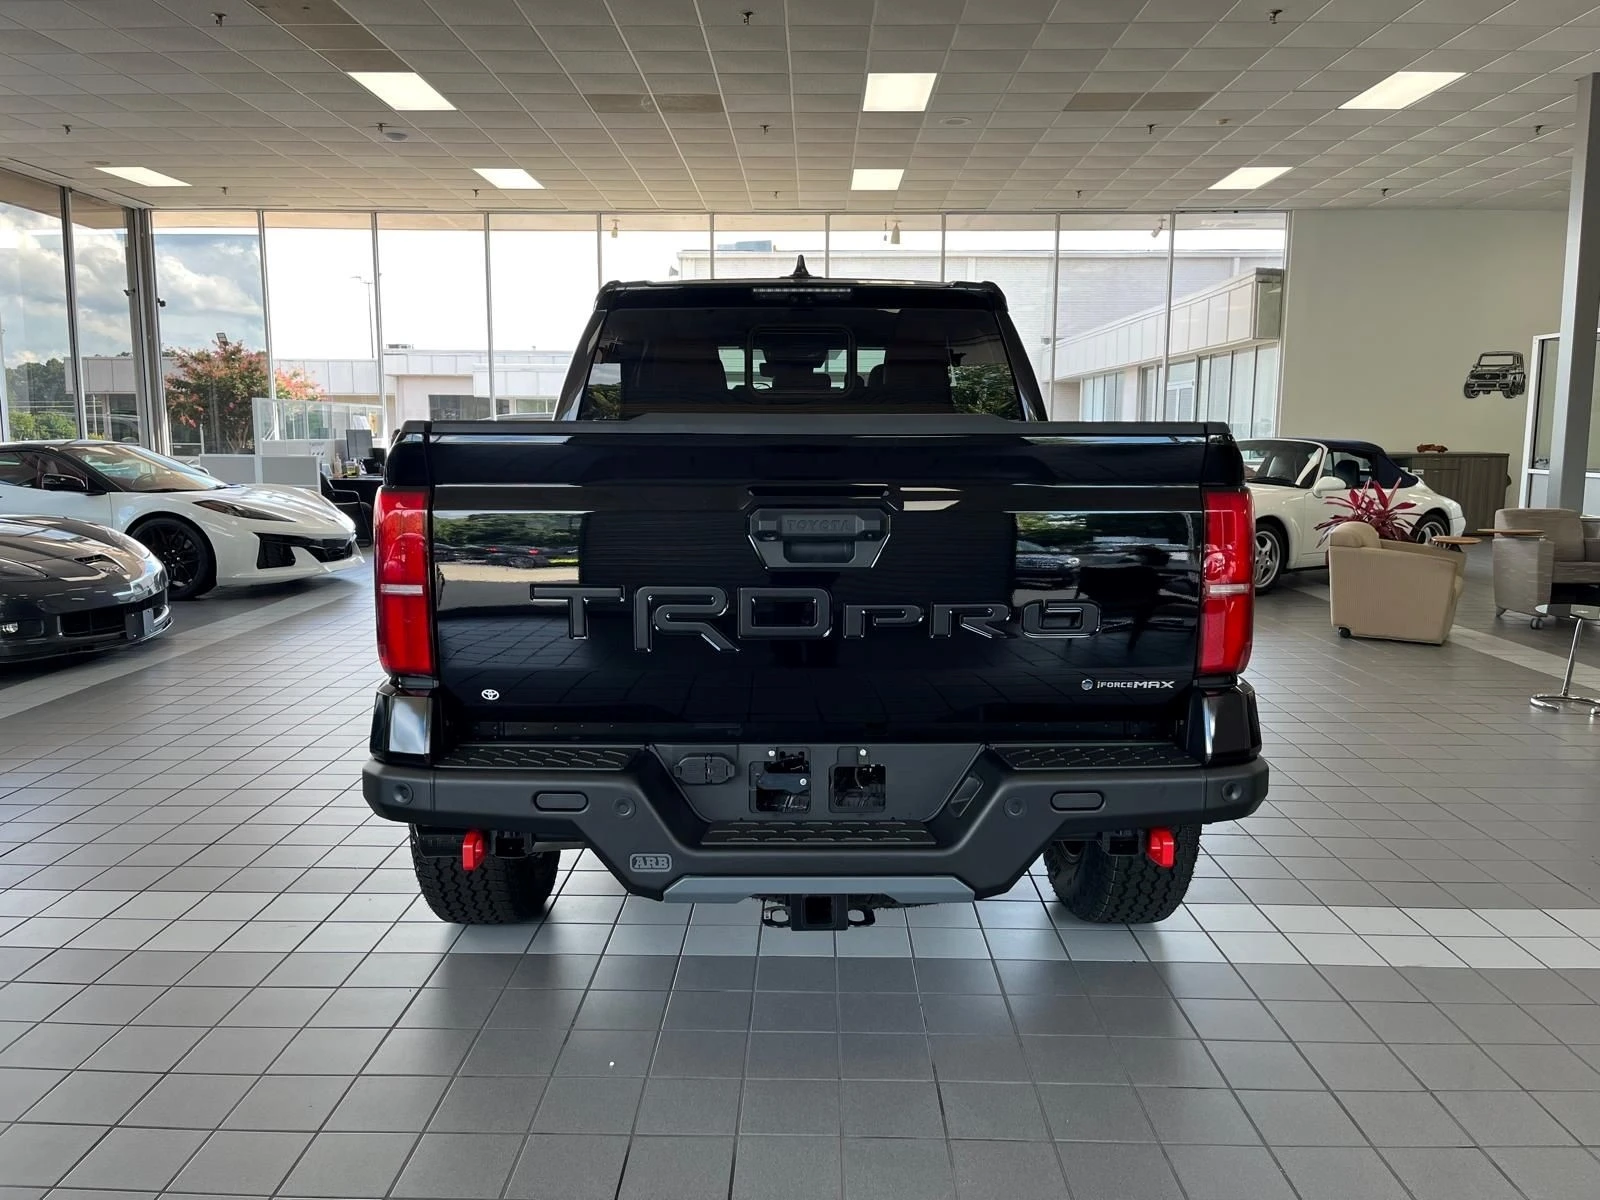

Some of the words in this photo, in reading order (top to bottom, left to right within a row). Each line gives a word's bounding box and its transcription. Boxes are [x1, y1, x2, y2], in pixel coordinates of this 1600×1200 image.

[786, 519, 850, 531] TOYOTA
[530, 583, 834, 653] TRD
[842, 599, 1102, 642] PRO
[634, 856, 669, 869] ARB
